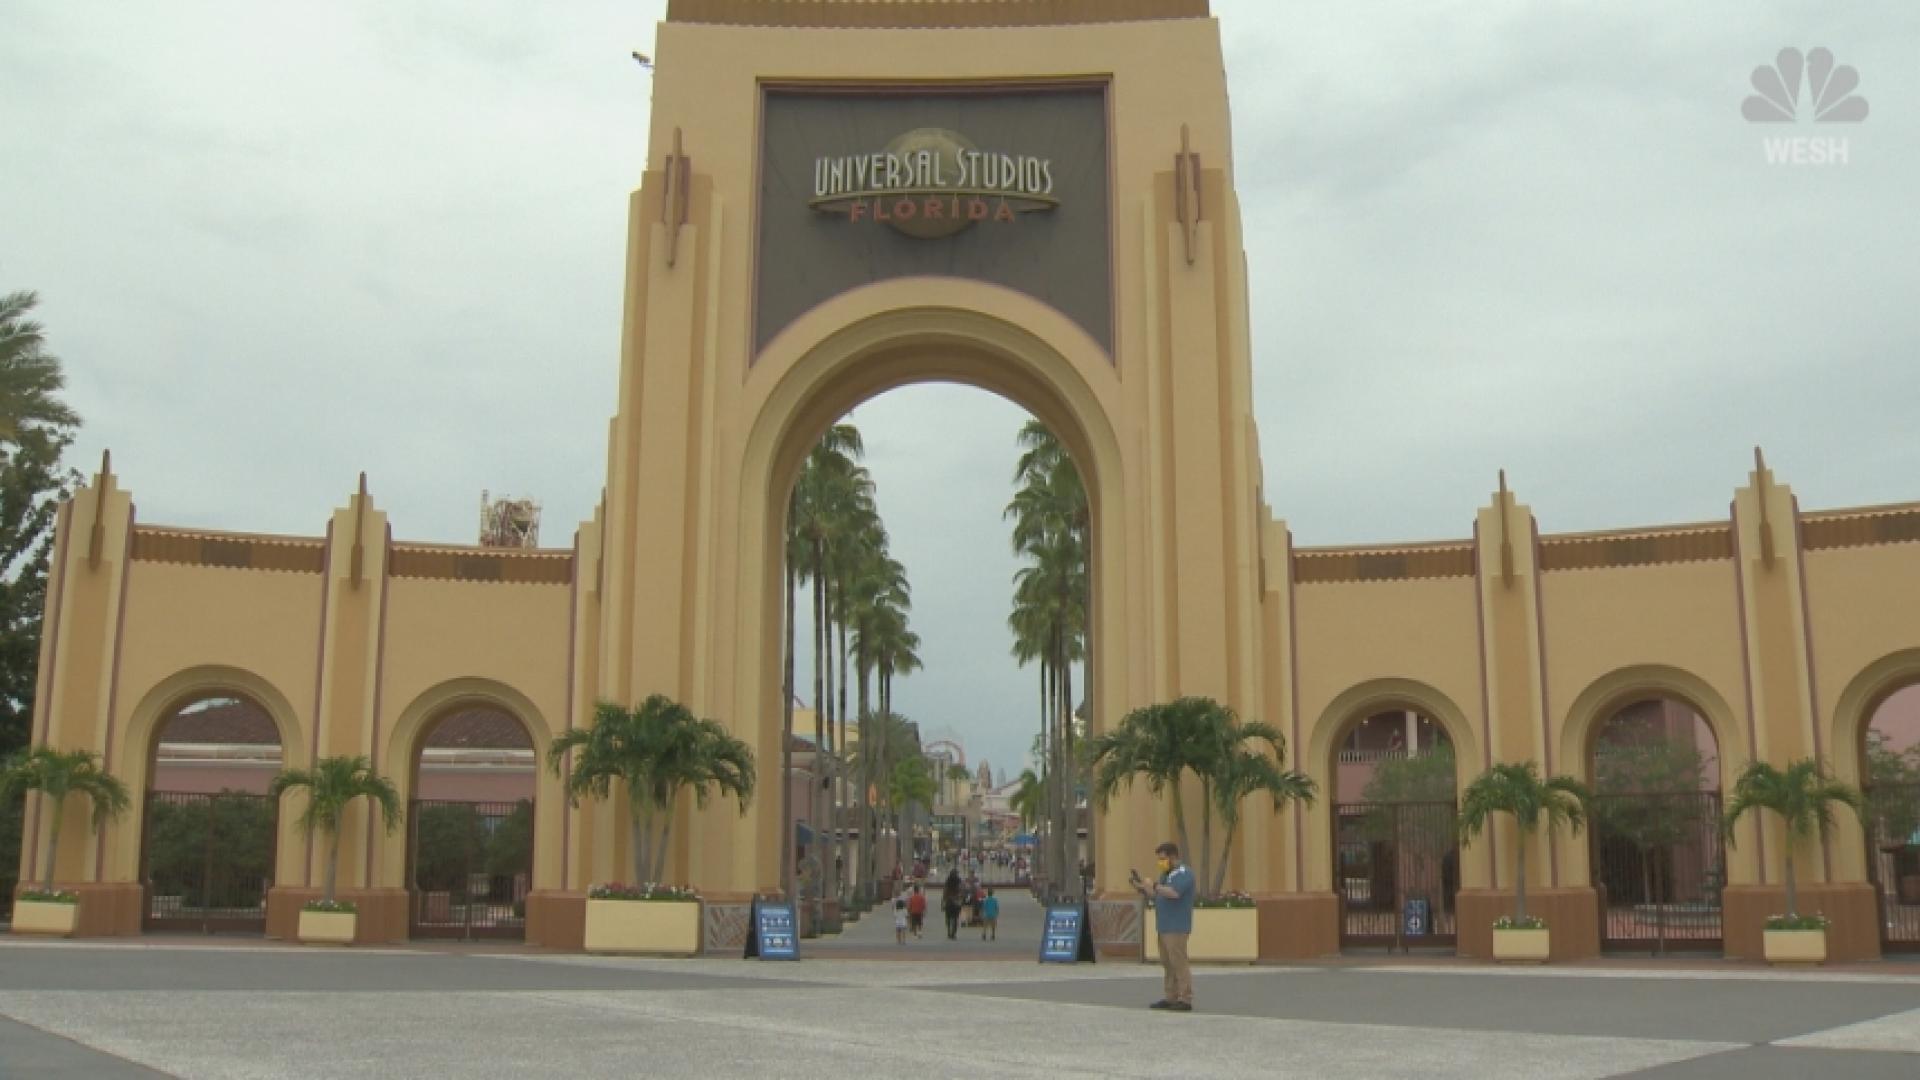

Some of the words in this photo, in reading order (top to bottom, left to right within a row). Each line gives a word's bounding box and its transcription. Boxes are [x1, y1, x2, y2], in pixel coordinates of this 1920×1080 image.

[815, 150, 946, 196] UNIVERSAL
[955, 148, 1053, 194] STUDIOS
[851, 200, 1015, 222] FLORIDA
